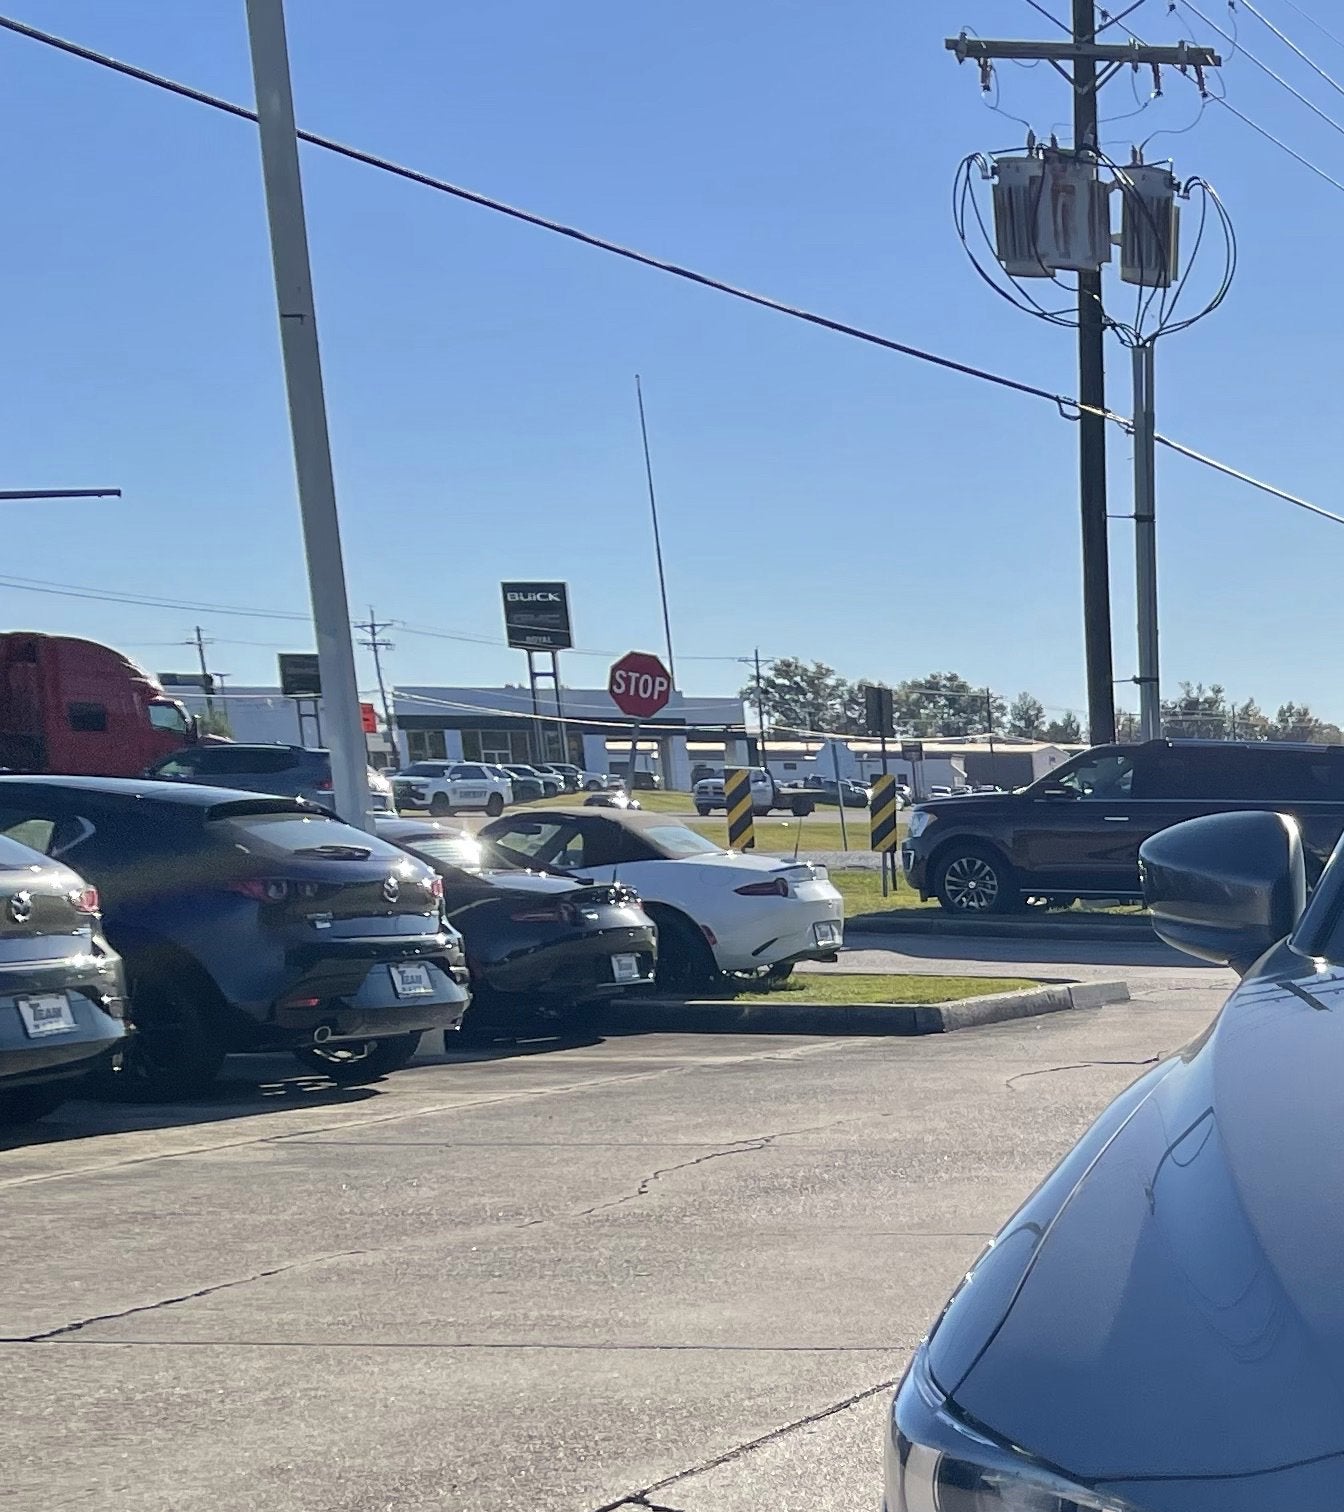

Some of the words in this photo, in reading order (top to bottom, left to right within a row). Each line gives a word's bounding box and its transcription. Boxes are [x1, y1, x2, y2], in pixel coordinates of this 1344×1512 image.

[506, 591, 561, 602] BUICK
[612, 670, 668, 700] STOP
[28, 1002, 63, 1021] TEAM
